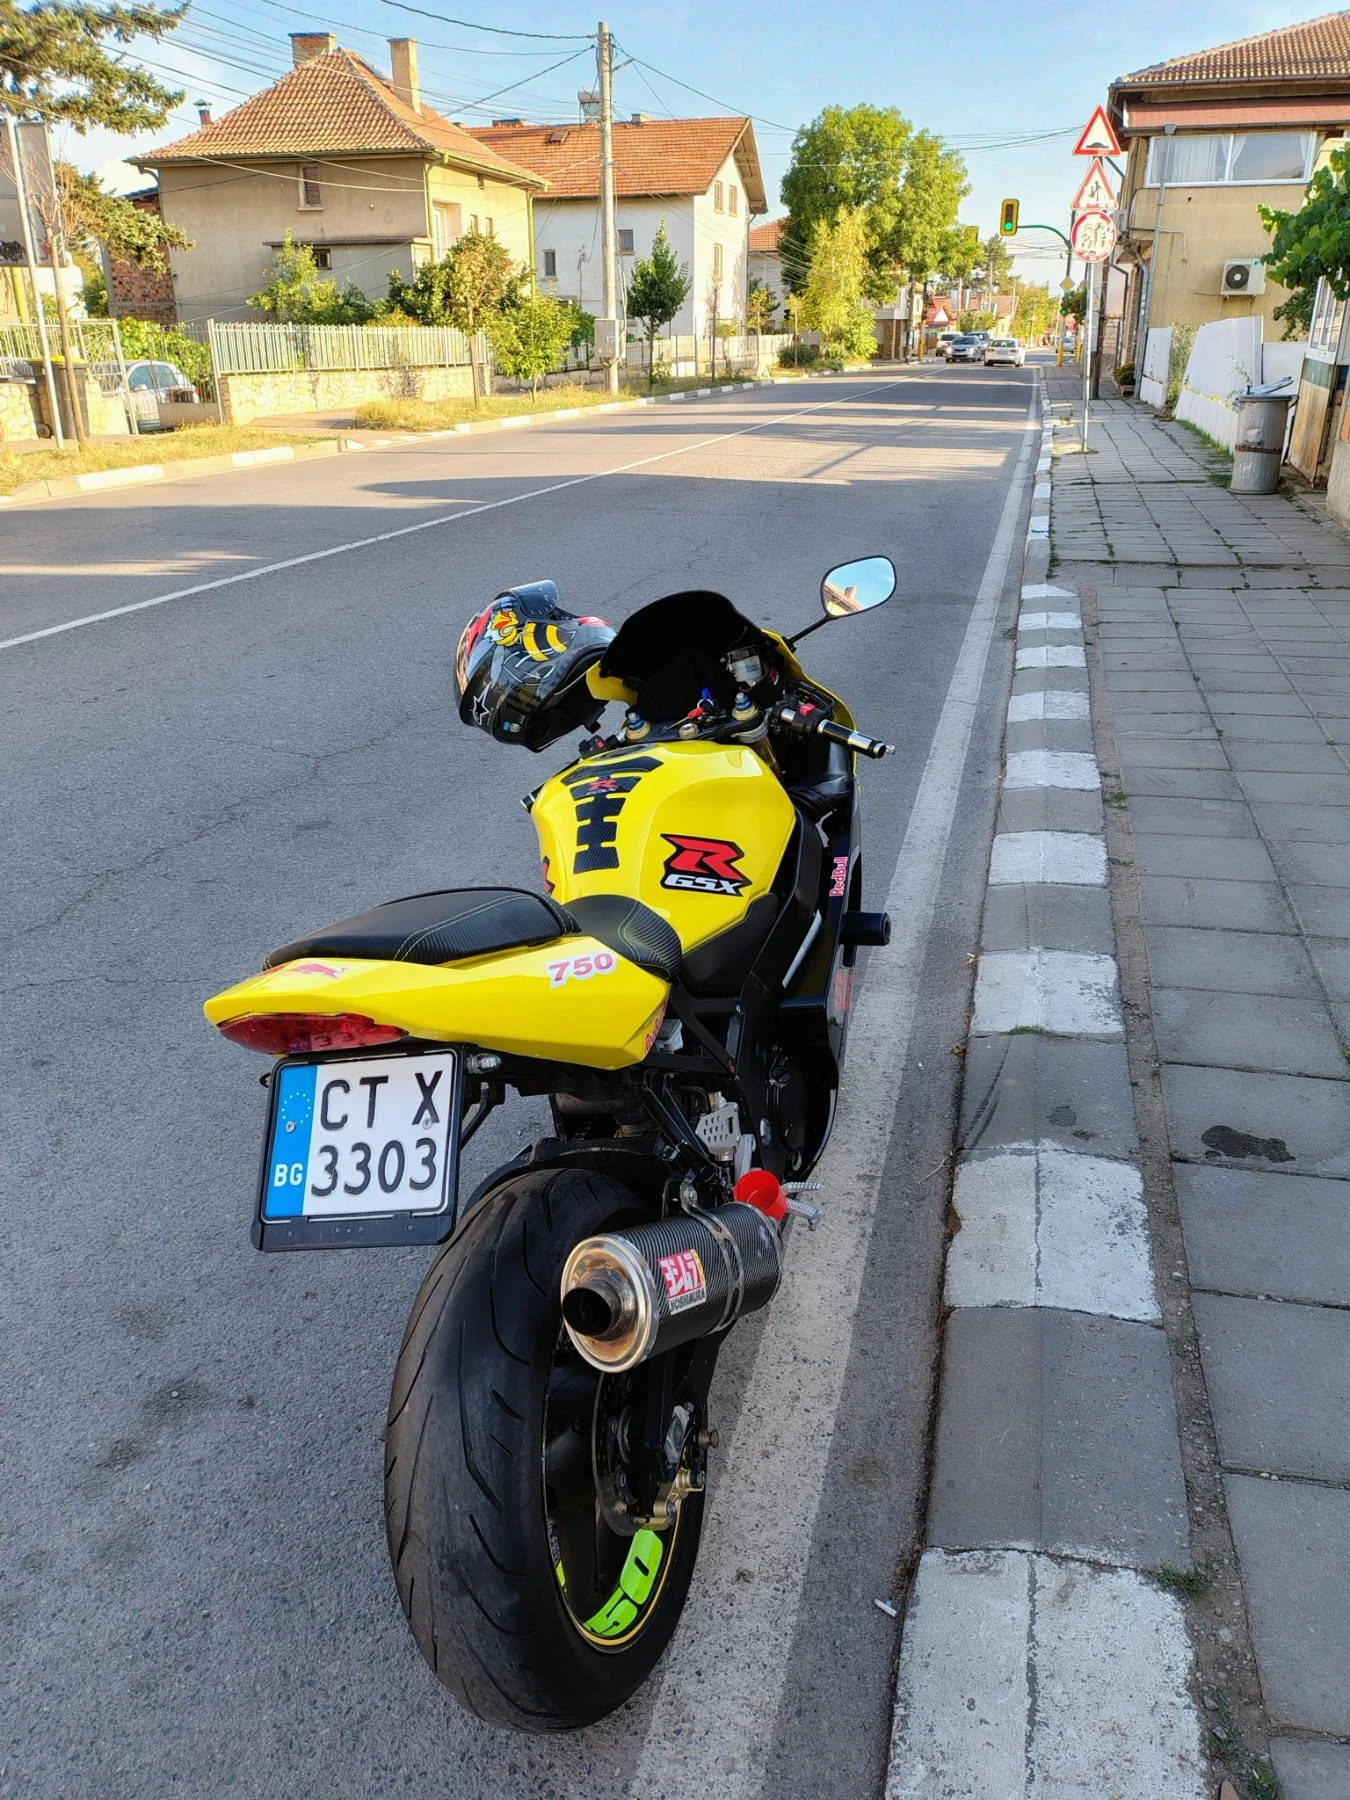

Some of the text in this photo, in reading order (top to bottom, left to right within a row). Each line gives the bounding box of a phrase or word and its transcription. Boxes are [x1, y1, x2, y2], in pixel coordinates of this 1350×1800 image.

[665, 836, 744, 881] R
[664, 874, 742, 895] GSX
[548, 952, 613, 983] 750
[320, 1070, 444, 1131] CT X
[273, 1163, 304, 1187] BG
[311, 1137, 437, 1197] 3303
